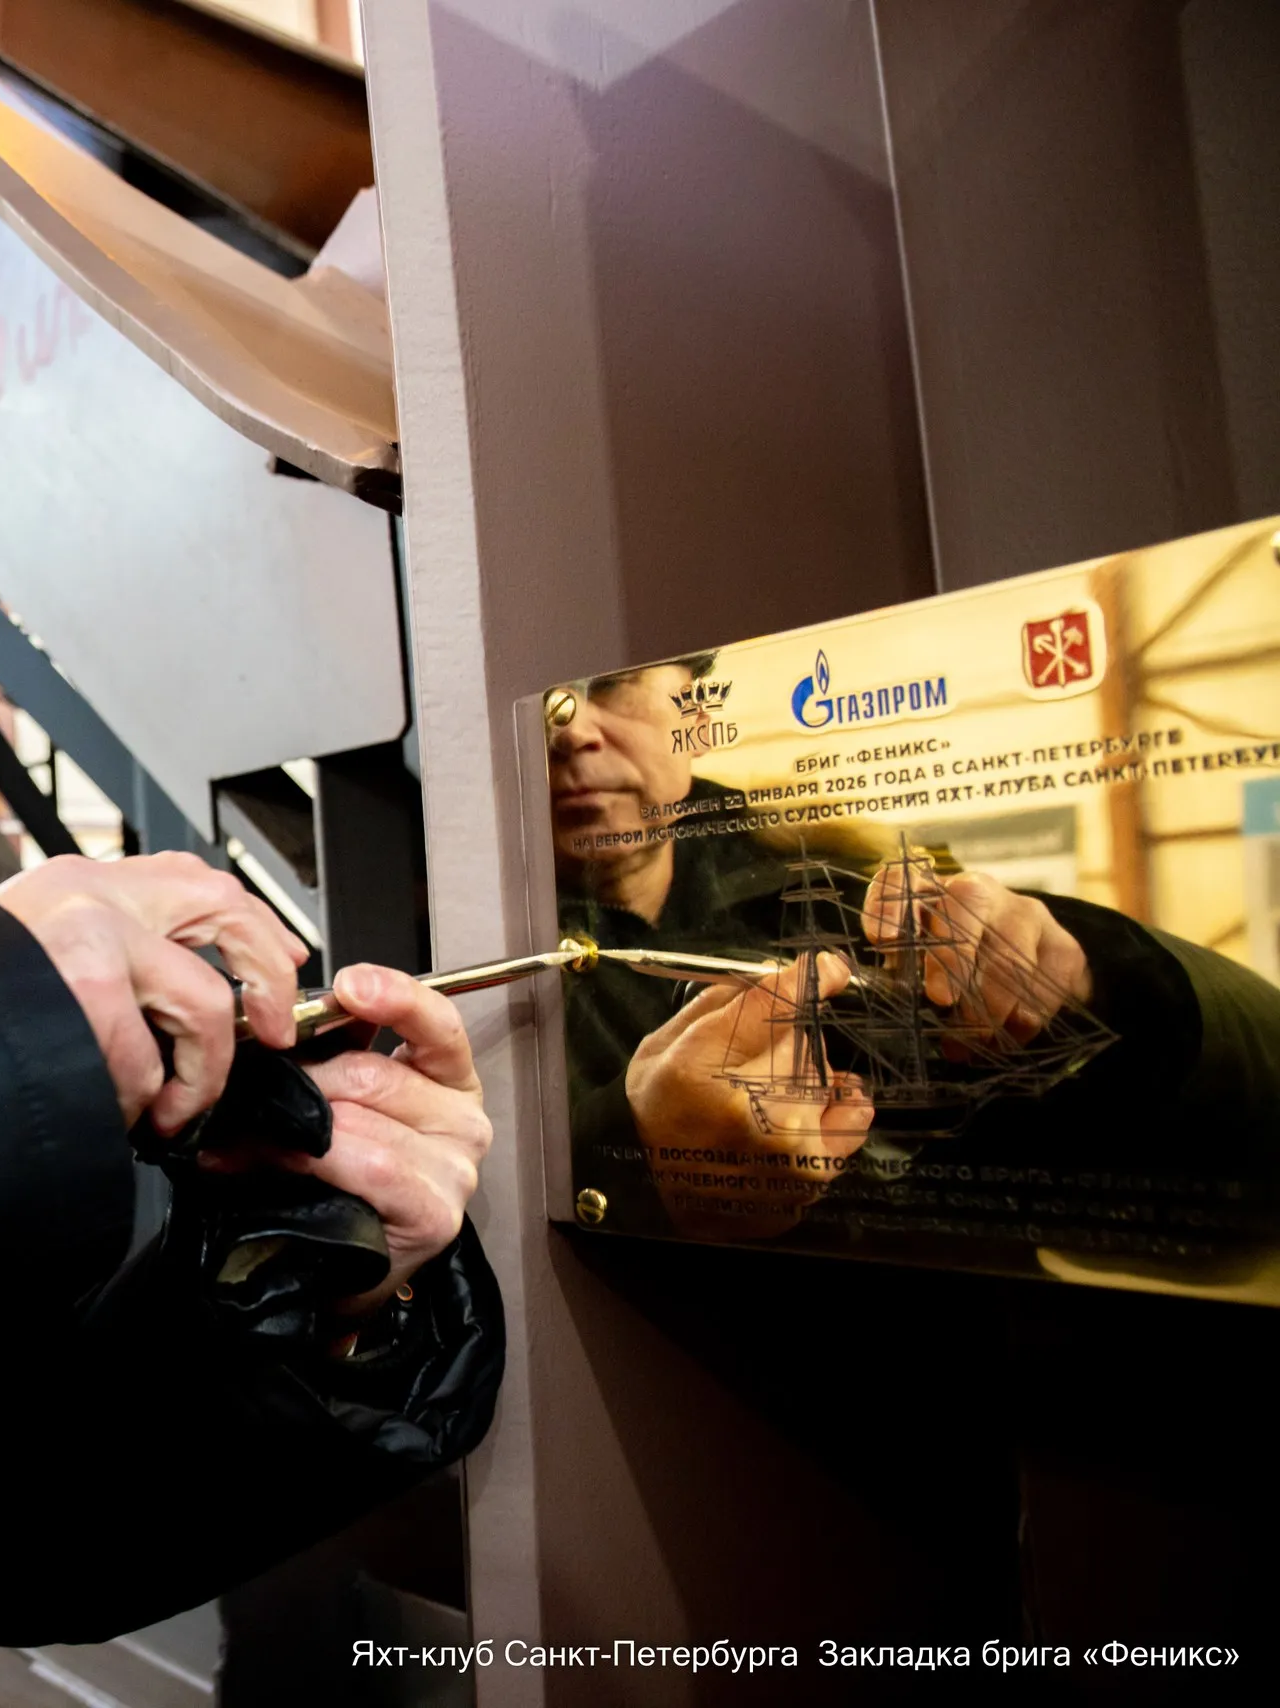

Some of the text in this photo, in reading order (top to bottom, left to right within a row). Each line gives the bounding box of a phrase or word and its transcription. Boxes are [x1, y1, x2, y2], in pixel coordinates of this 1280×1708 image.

[836, 677, 948, 725] ГАЗПРОМ
[671, 721, 738, 755] ЯКСПБ
[796, 739, 951, 774] БРИГ «ФЕНИКС»
[749, 782, 819, 804] ЯНВАРЯ
[825, 775, 867, 794] 2026
[874, 766, 927, 787] ГОДА
[933, 763, 945, 778] В
[952, 728, 1183, 776] САНКТ-ПЕТЕРБУРГЕ
[595, 829, 644, 848] ВЕРФИ
[646, 811, 781, 842] ИСТОРИЧЕСКОГО
[784, 791, 929, 824] СУДОСТРОЕНИЯ
[936, 773, 1057, 806] ЯХТ-КЛУБА
